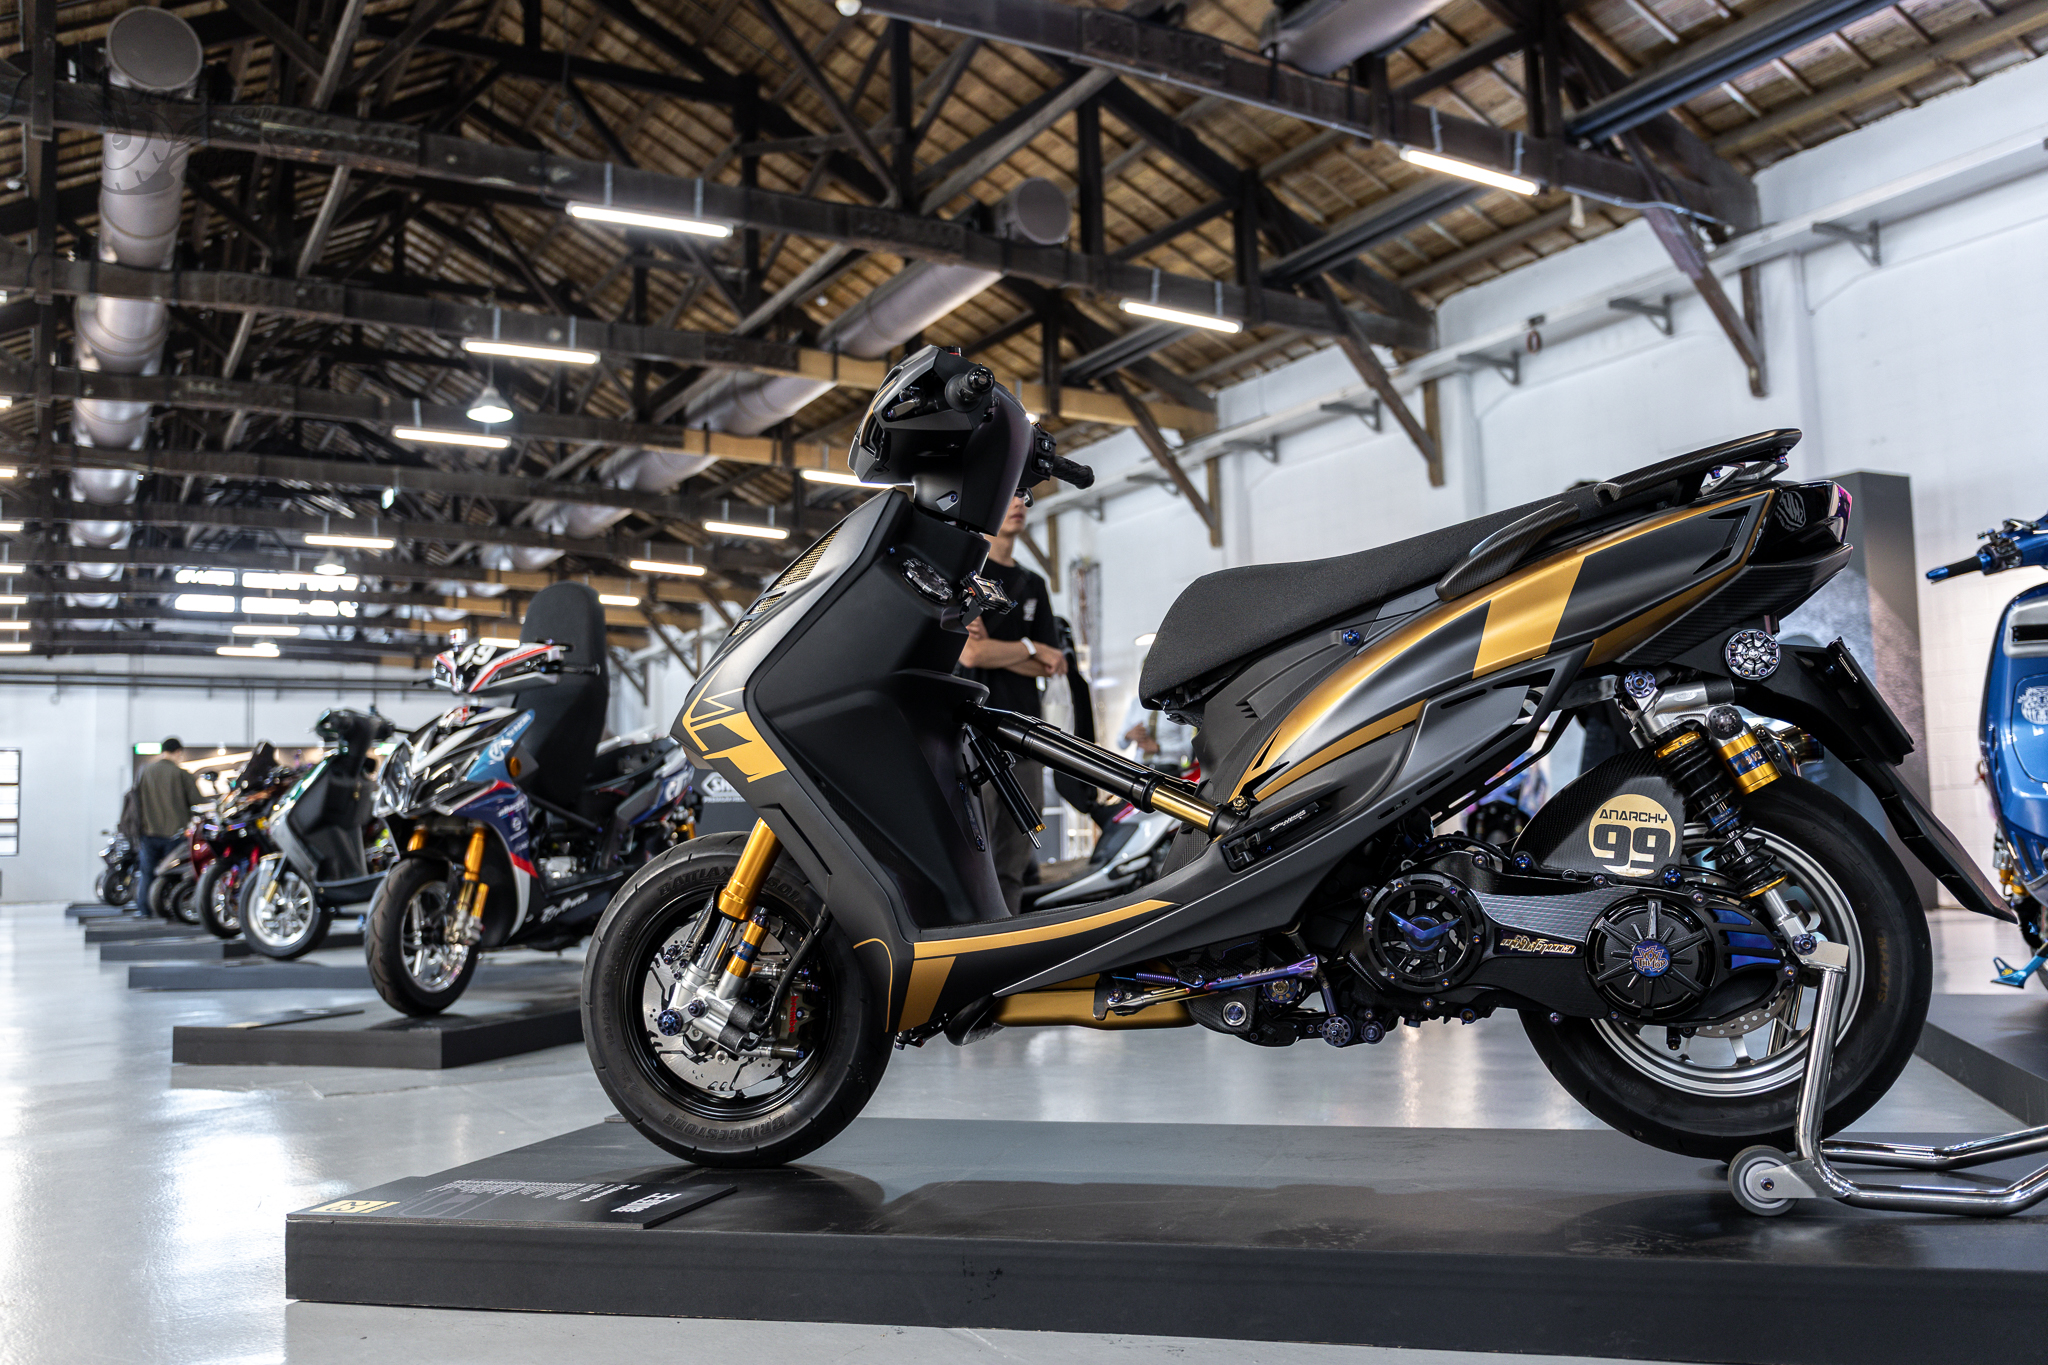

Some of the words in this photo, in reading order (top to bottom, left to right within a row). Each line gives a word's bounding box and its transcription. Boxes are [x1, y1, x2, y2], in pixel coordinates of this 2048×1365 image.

[1599, 808, 1668, 824] ANARCHY
[1592, 824, 1671, 871] 99
[1876, 935, 1890, 1003] MAXXIS
[788, 995, 800, 1033] brembo
[663, 1111, 787, 1140] BRIDGESTONE
